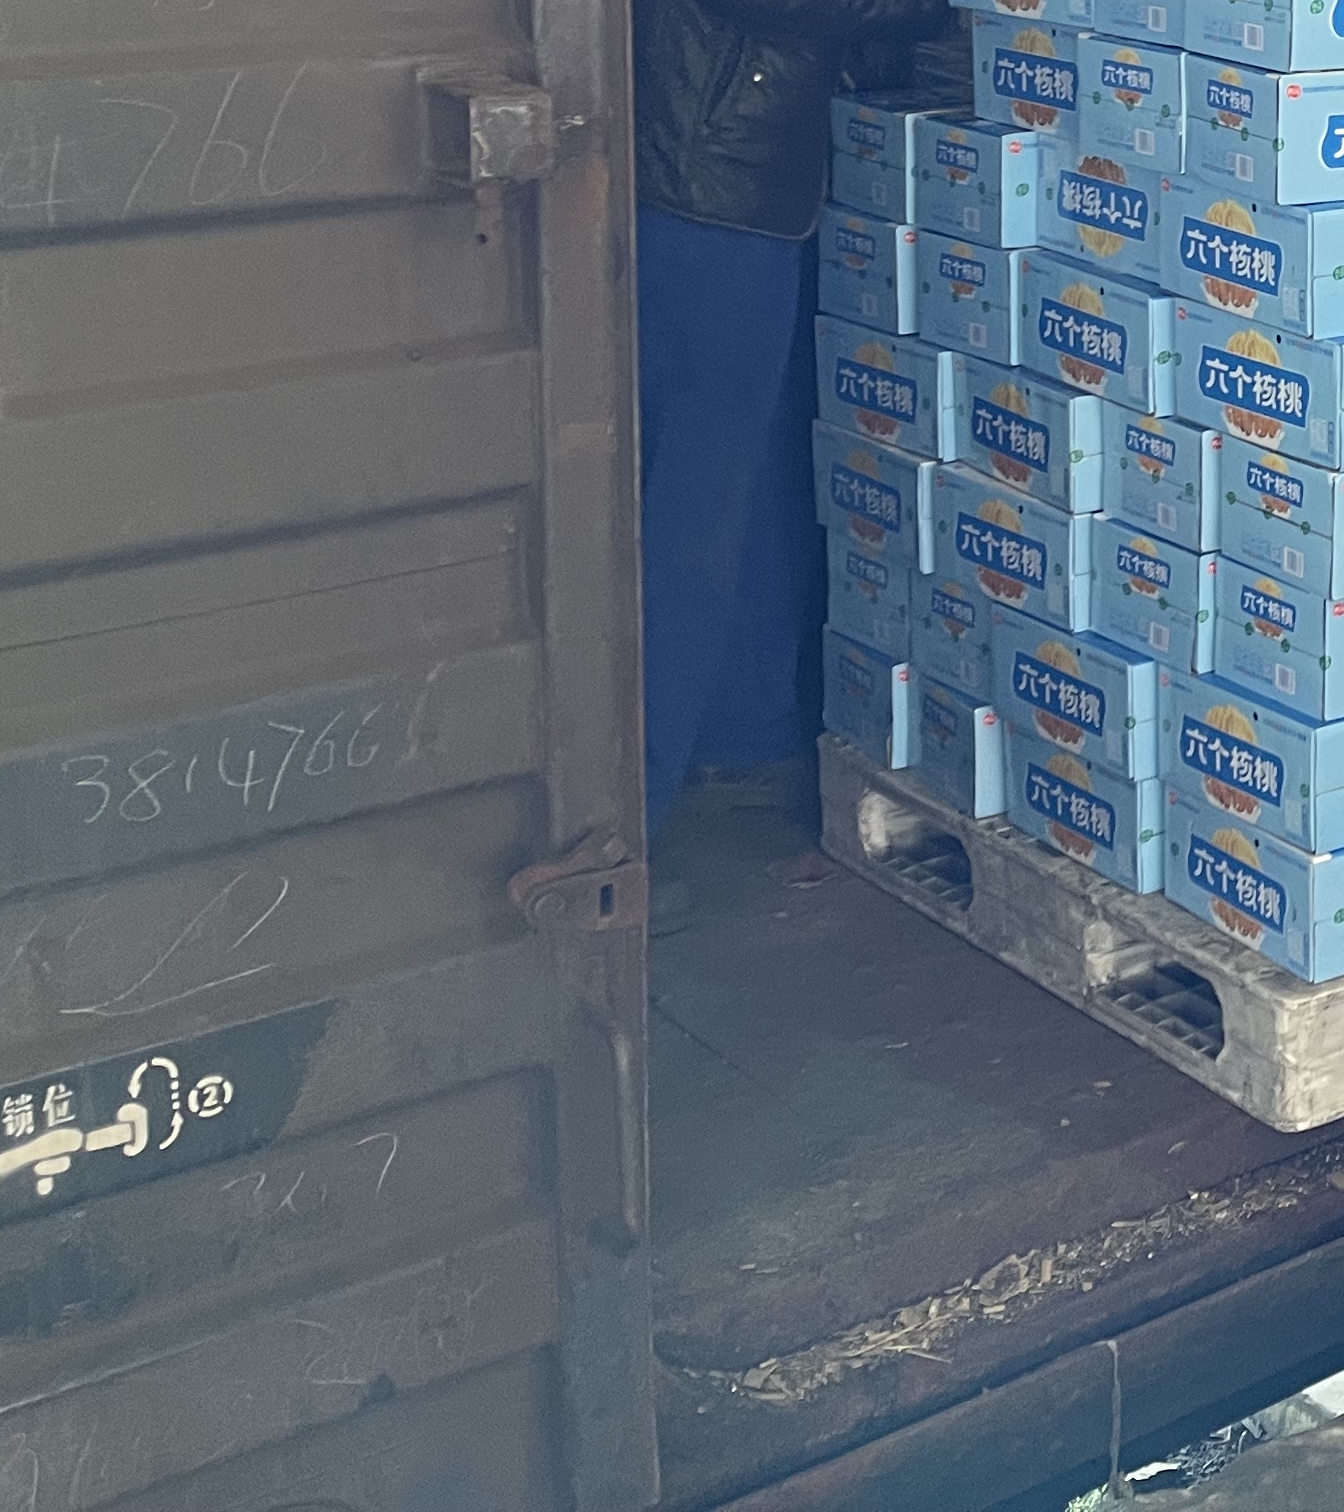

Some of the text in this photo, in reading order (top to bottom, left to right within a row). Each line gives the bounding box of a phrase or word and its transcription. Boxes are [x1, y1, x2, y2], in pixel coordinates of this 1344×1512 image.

[997, 58, 1074, 102] 六个核桃
[1104, 66, 1150, 90] 六个核桃
[1209, 85, 1252, 112] 六个核桃
[937, 146, 977, 168] 六个核桃
[1062, 179, 1143, 230] 六个核桃
[942, 259, 984, 283] 六个核桃
[1186, 228, 1275, 287] 六个核桃
[1043, 308, 1122, 365] 六个核桃
[839, 367, 914, 417] 六个核桃
[1206, 357, 1303, 417] 六个核桃
[975, 408, 1046, 465] 六个核桃
[1127, 430, 1174, 460] 六个核桃
[1249, 466, 1301, 503] 六个核桃
[960, 523, 1043, 581] 六个核桃
[1119, 550, 1168, 583] 六个核桃
[1242, 591, 1294, 627] 六个核桃
[1018, 662, 1100, 728] 六个核桃
[1186, 728, 1277, 798] 六个核桃
[1031, 774, 1110, 843] 六个核桃
[1193, 848, 1281, 925] 六个核桃
